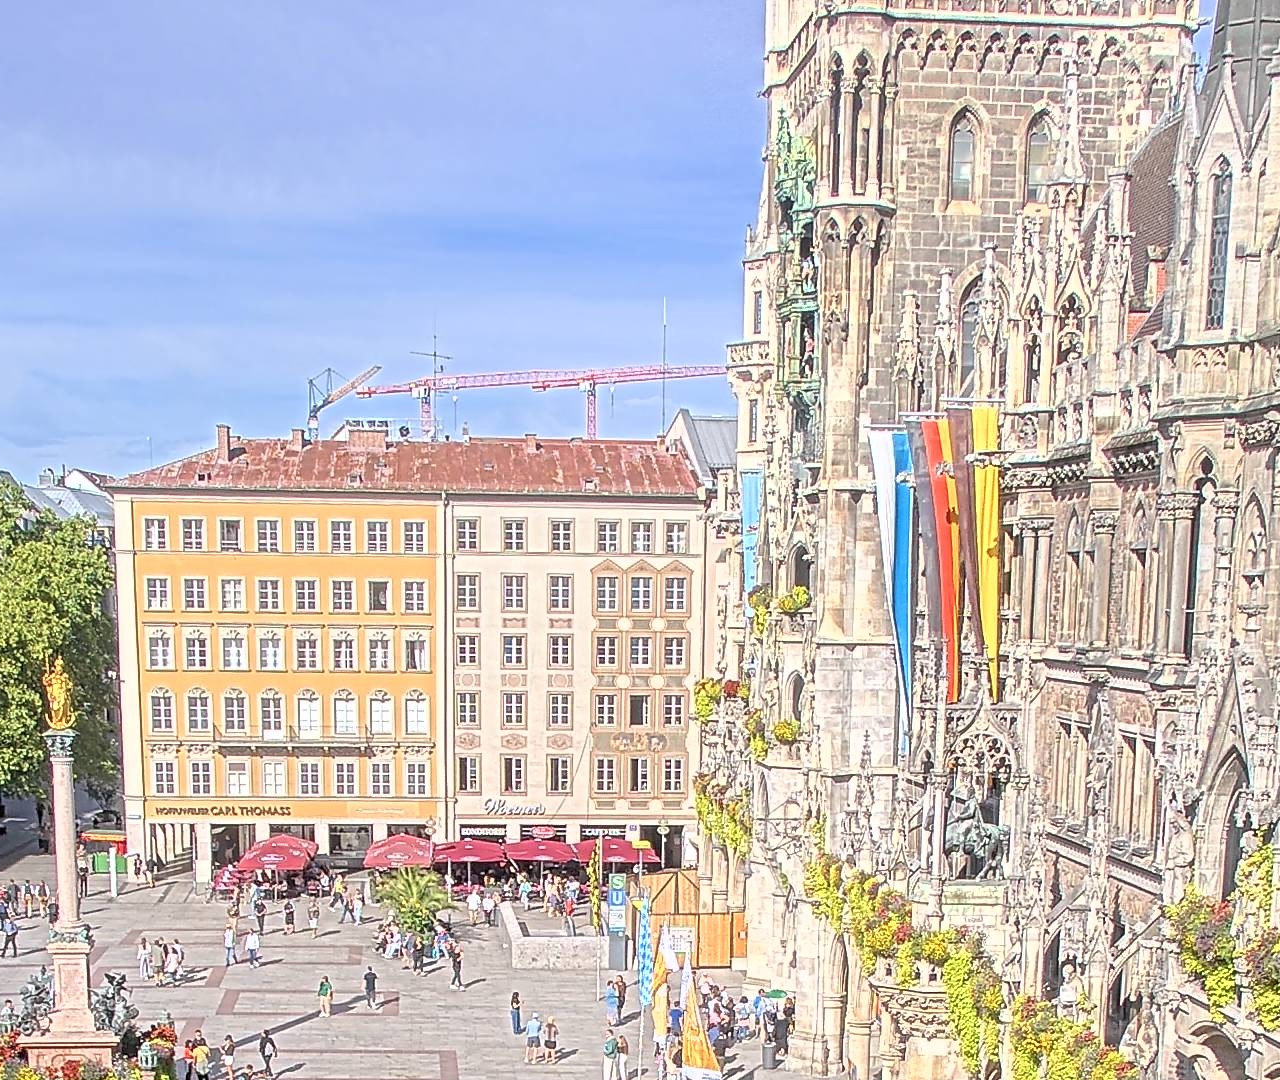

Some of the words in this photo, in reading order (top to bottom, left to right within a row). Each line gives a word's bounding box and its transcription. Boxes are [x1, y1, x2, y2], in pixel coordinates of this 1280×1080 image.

[210, 806, 238, 816] CARL
[239, 806, 291, 816] THOMASS
[612, 876, 623, 889] S
[613, 891, 622, 904] U
